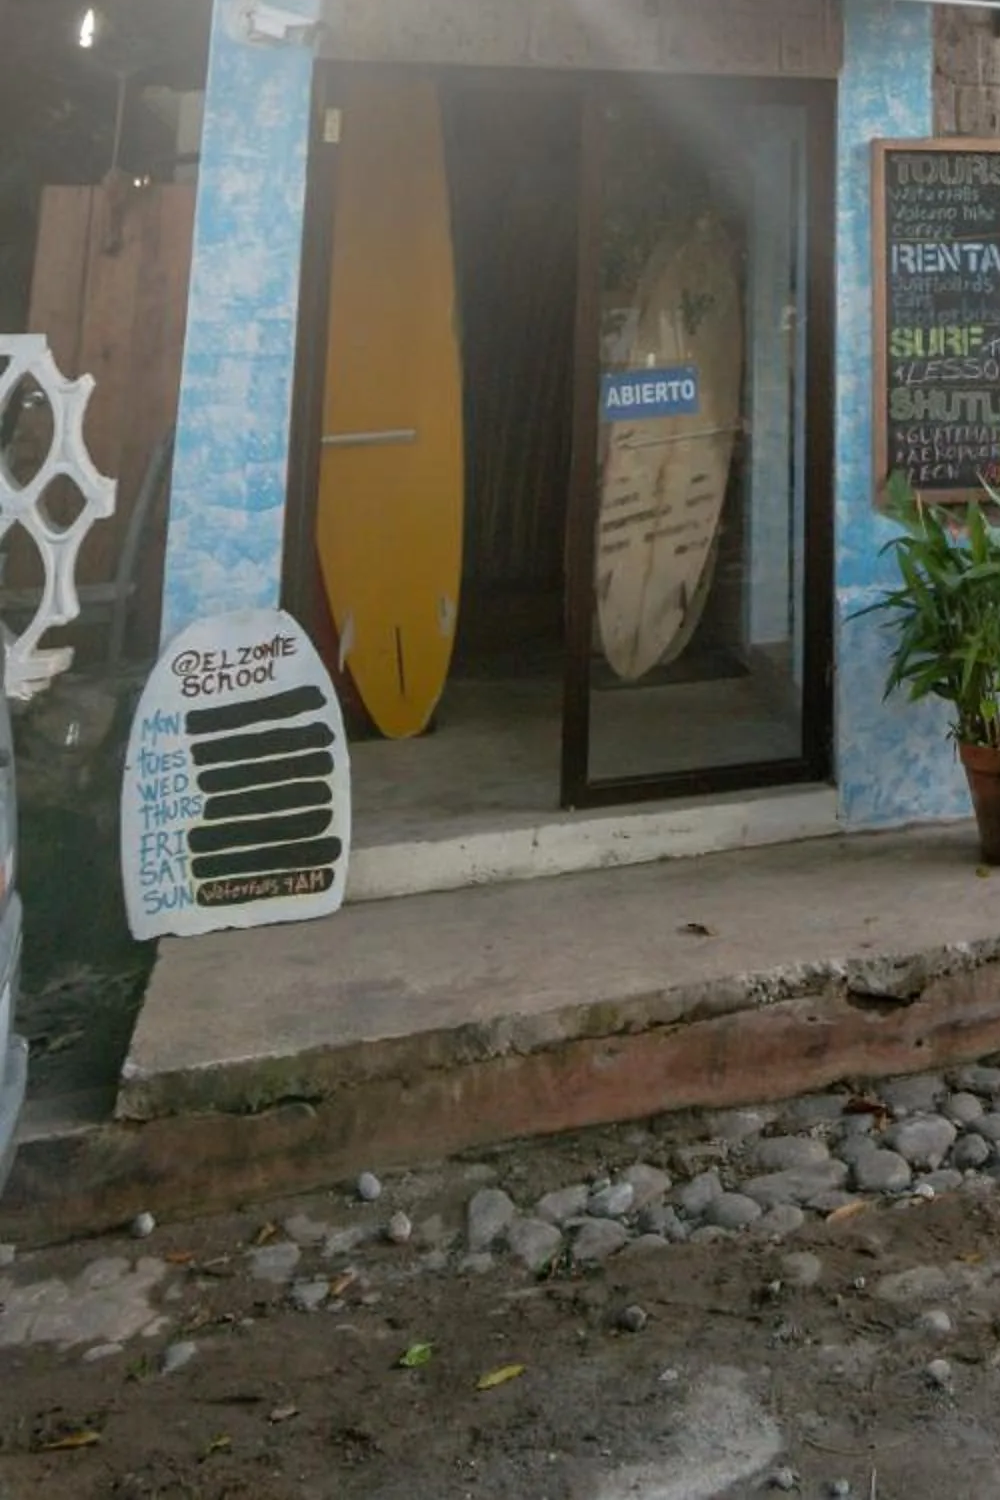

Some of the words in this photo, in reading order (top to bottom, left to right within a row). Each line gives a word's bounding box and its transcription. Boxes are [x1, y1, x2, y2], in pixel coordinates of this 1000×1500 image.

[890, 327, 984, 357] SURF
[606, 379, 695, 407] ABIERTO
[139, 748, 187, 778] TUES
[136, 774, 189, 802] WED
[138, 795, 203, 830] THURS
[140, 829, 186, 863] FRI
[140, 856, 190, 886] SAT
[142, 882, 194, 915] SUN
